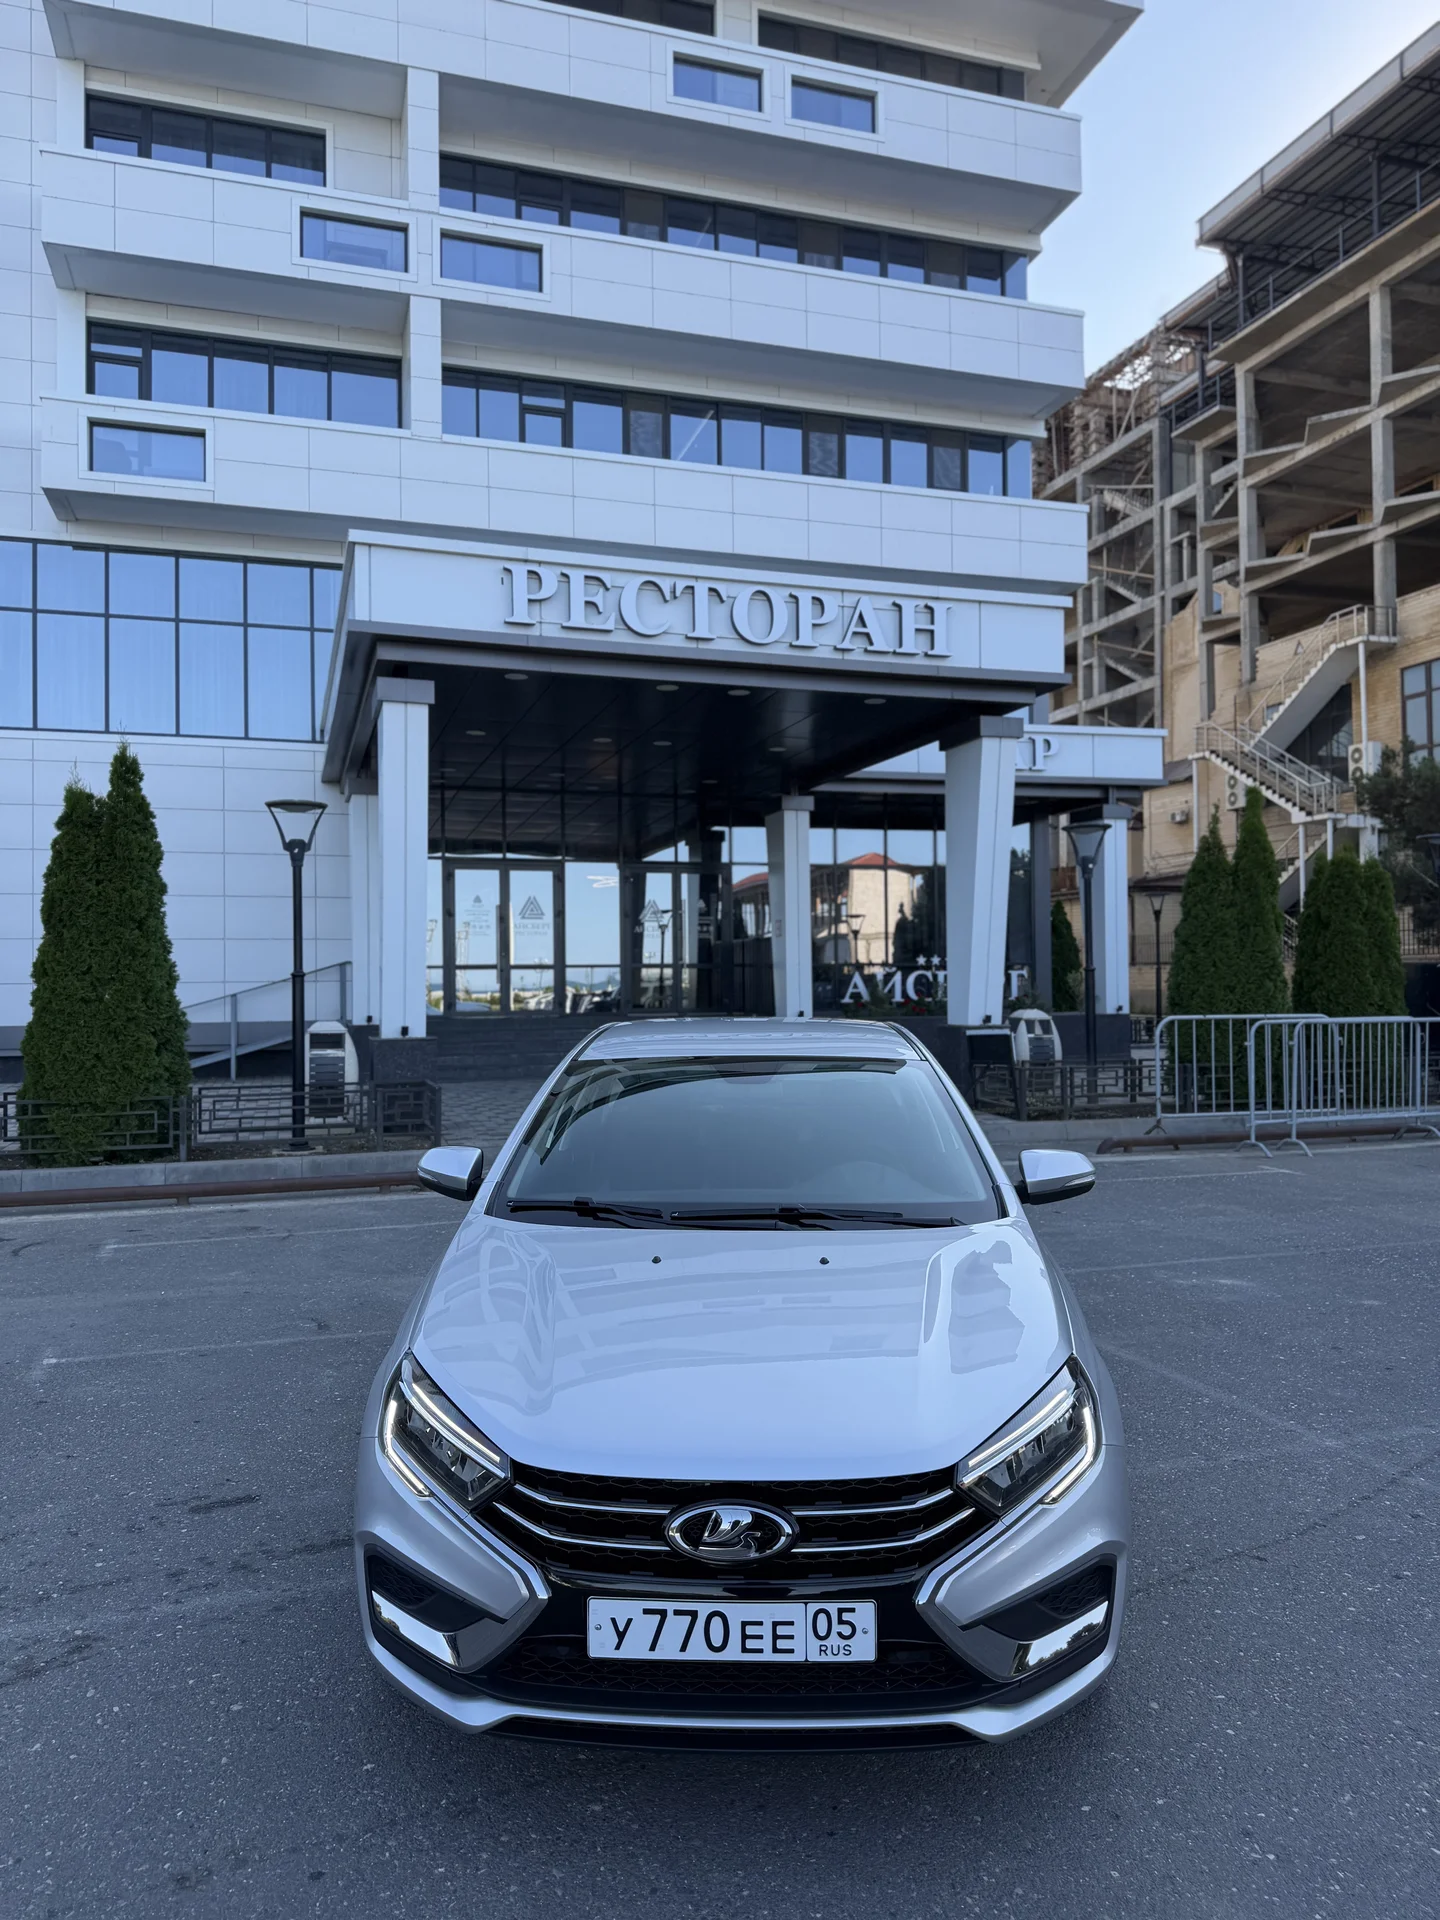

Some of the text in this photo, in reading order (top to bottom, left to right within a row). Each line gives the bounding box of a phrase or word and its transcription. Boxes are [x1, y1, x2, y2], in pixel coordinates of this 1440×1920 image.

[502, 565, 953, 658] РЕСТОРАН
[609, 1607, 857, 1654] У770ЕЕ 05
[819, 1644, 852, 1657] RUS
